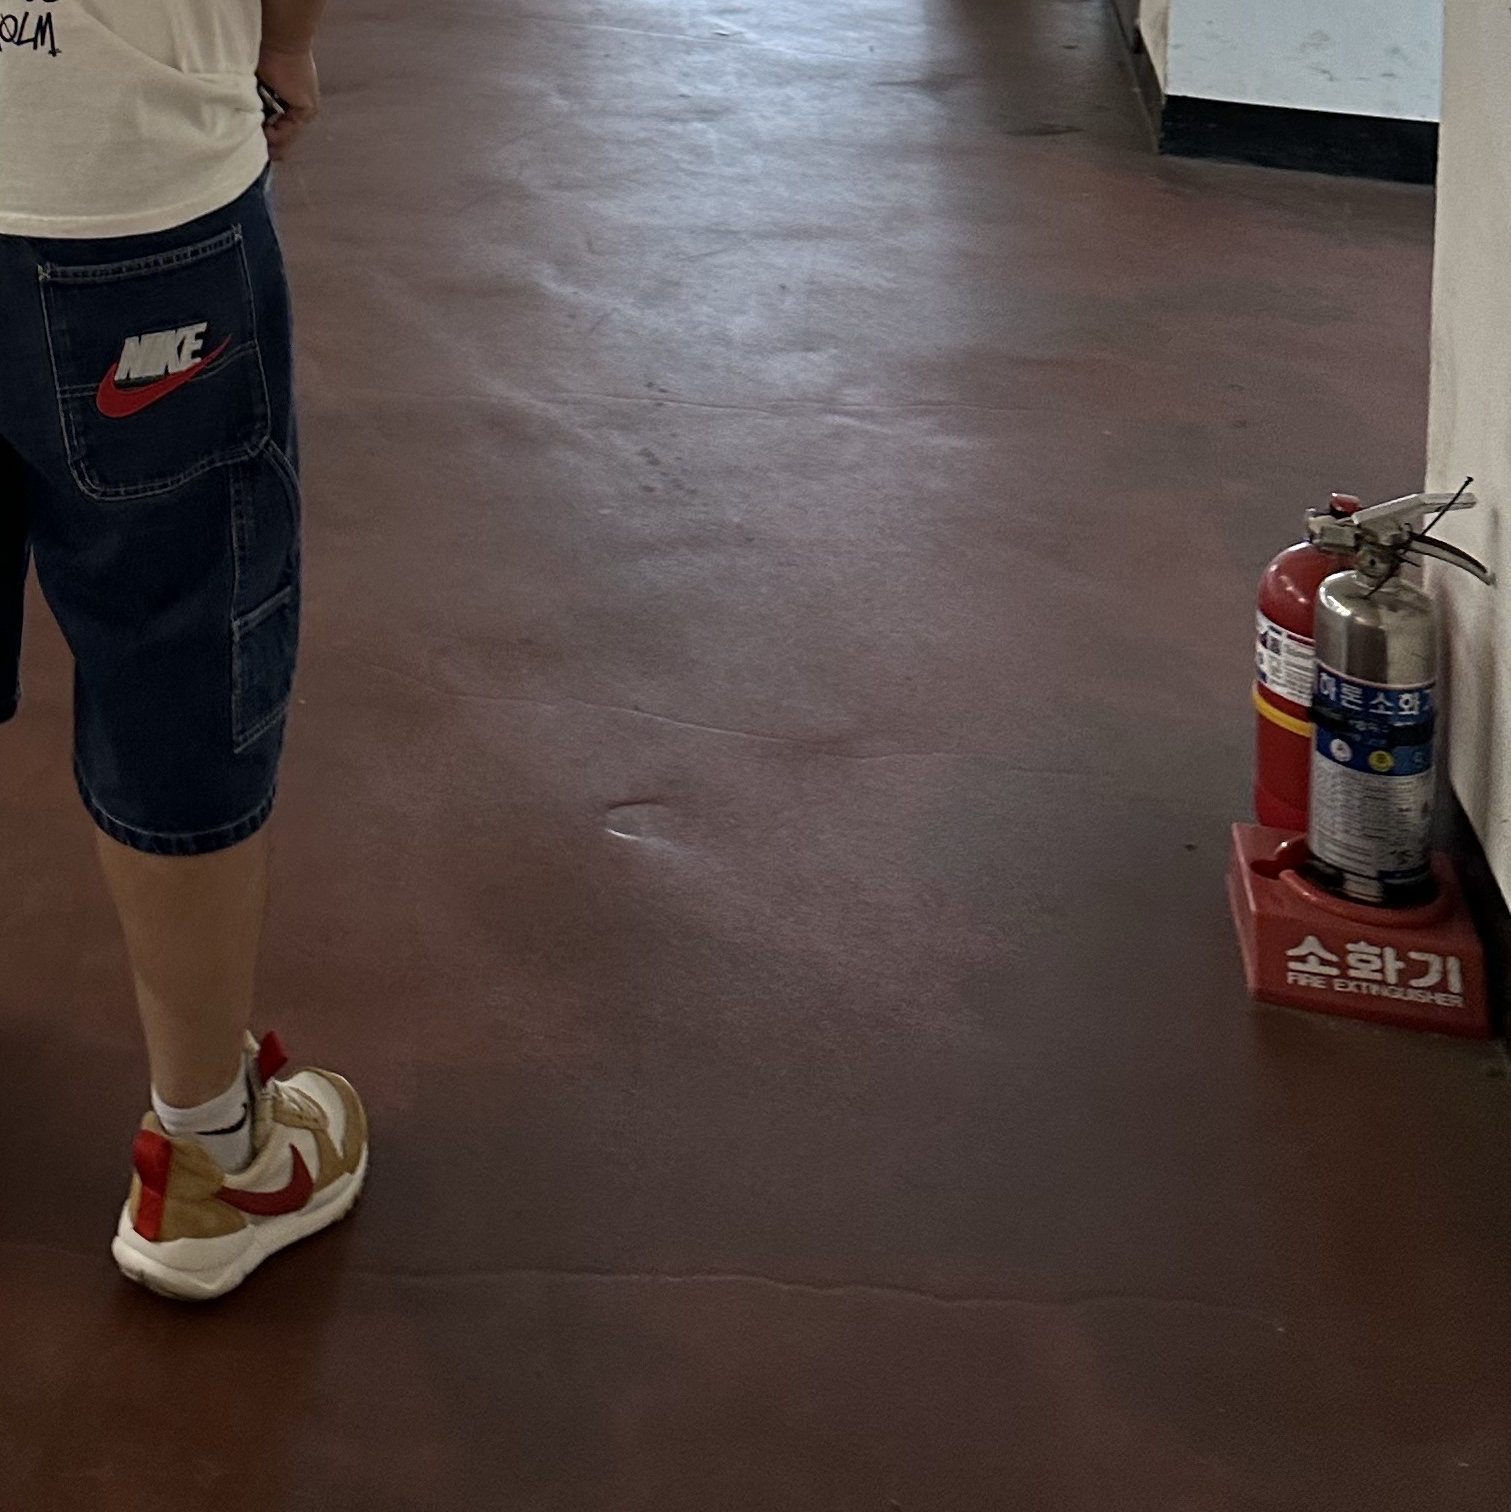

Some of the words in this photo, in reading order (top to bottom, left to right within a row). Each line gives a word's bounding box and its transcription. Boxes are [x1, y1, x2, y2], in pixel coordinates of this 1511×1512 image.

[114, 321, 208, 383] NIKE
[1286, 935, 1464, 994] 소화기
[1287, 972, 1328, 989] FIRE
[1332, 978, 1465, 1009] EXTINGUISHER
